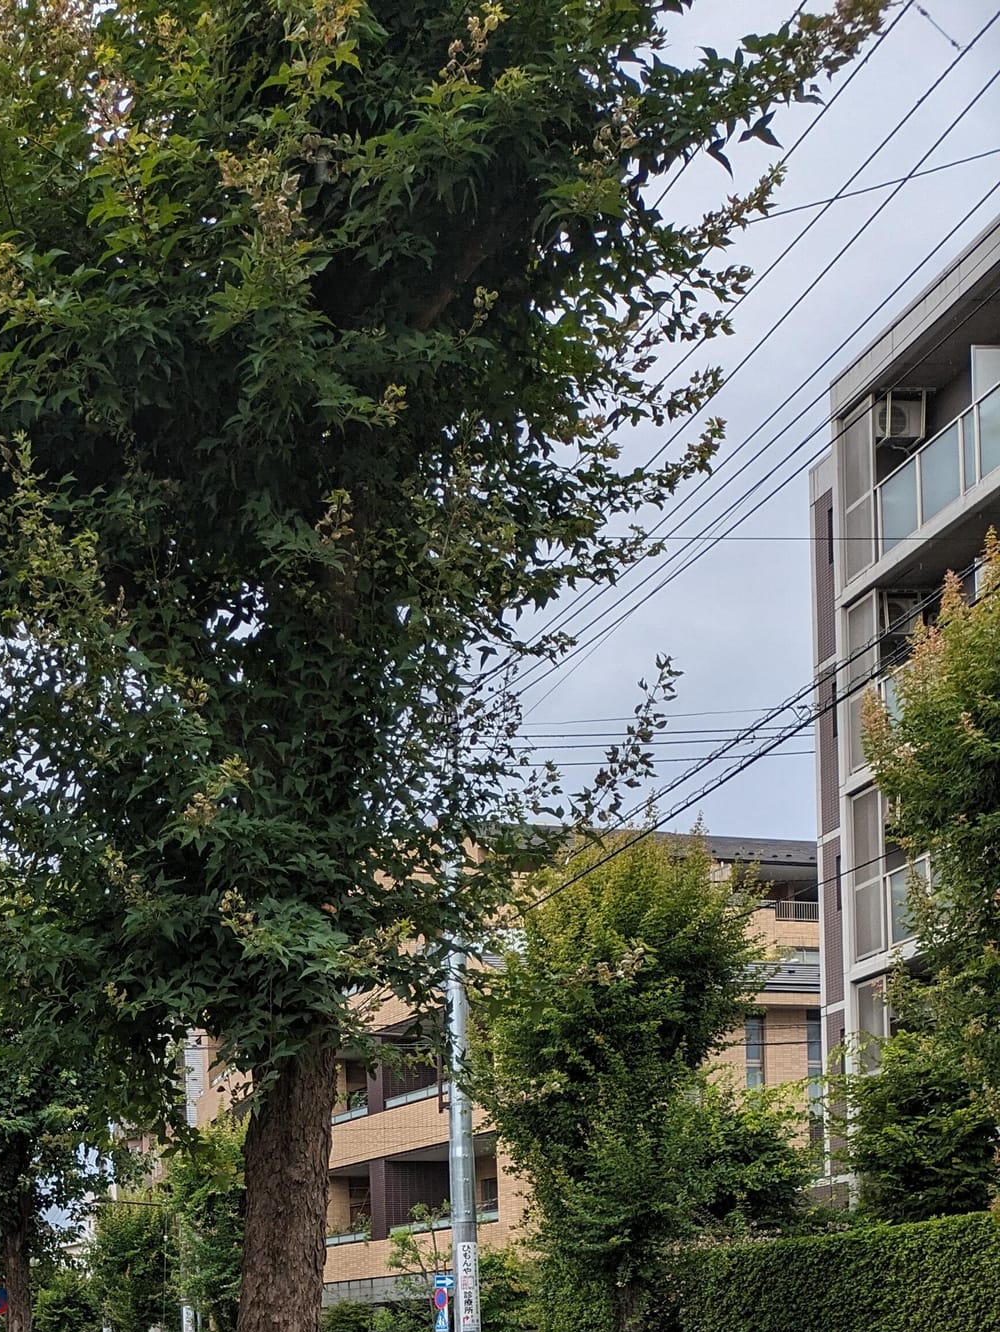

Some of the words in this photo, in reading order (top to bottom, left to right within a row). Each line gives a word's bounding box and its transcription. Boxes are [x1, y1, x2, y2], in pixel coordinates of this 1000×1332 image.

[462, 1244, 472, 1275] ひもんや
[464, 1291, 473, 1314] 診療所
